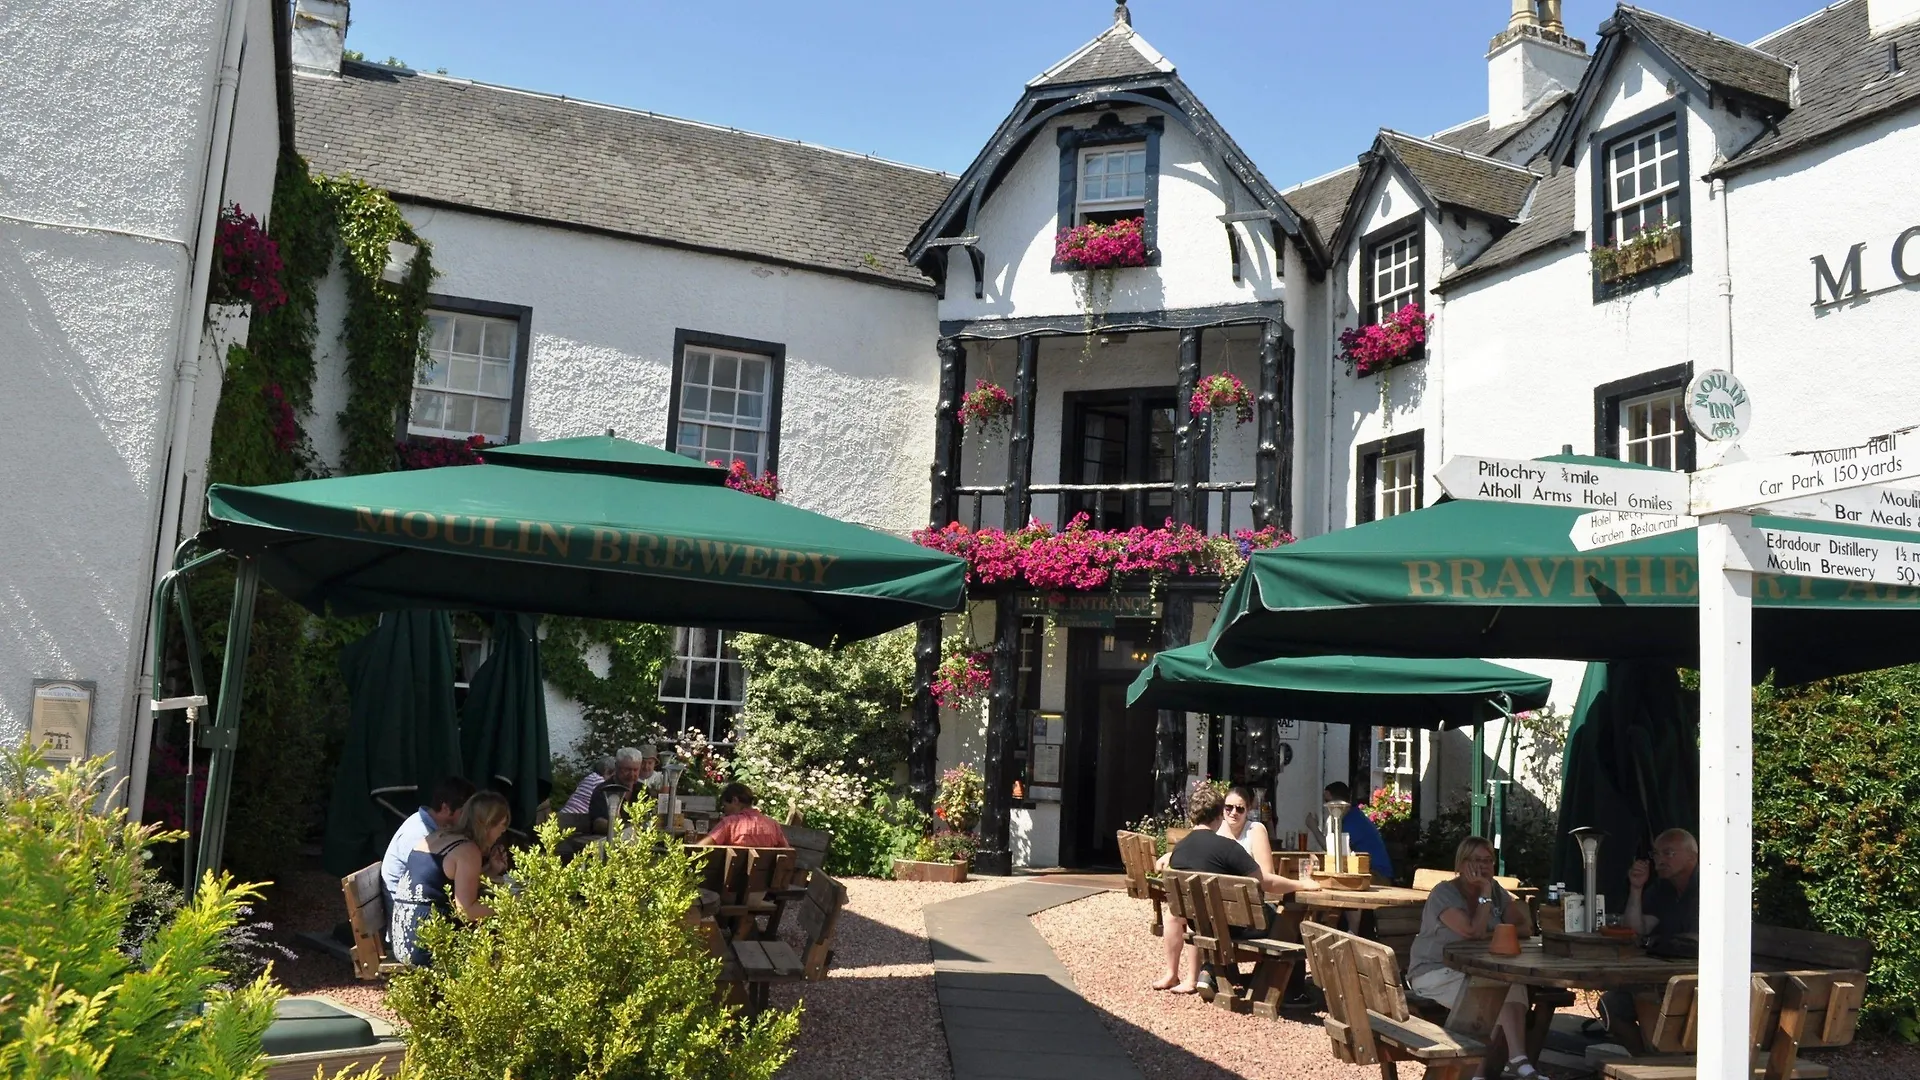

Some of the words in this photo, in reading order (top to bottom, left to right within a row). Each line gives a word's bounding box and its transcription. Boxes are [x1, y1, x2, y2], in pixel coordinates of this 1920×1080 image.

[1695, 374, 1746, 408] MOULIN
[1708, 402, 1735, 419] INN
[1868, 434, 1897, 456] Hall
[1479, 461, 1546, 483] Pitlochry
[1759, 480, 1783, 495] Car
[1792, 470, 1824, 490] Park
[1479, 481, 1522, 499] Atholl
[1533, 486, 1572, 503] Arms
[1584, 489, 1617, 507] Hotel
[1591, 512, 1612, 528] Hotel
[1835, 504, 1863, 521] Bar
[1870, 509, 1912, 527] Meals
[1591, 529, 1624, 545] Garden
[1630, 515, 1679, 537] Restaurant
[353, 505, 575, 558] MOULIN
[586, 525, 840, 586] BREWERY
[1766, 533, 1821, 553] Edradour
[1829, 540, 1879, 561] Distillery
[1767, 554, 1811, 572] Moulin
[1821, 559, 1876, 581] Brewery
[1018, 596, 1061, 610] HOT
[1069, 596, 1150, 610] ENTRANCE
